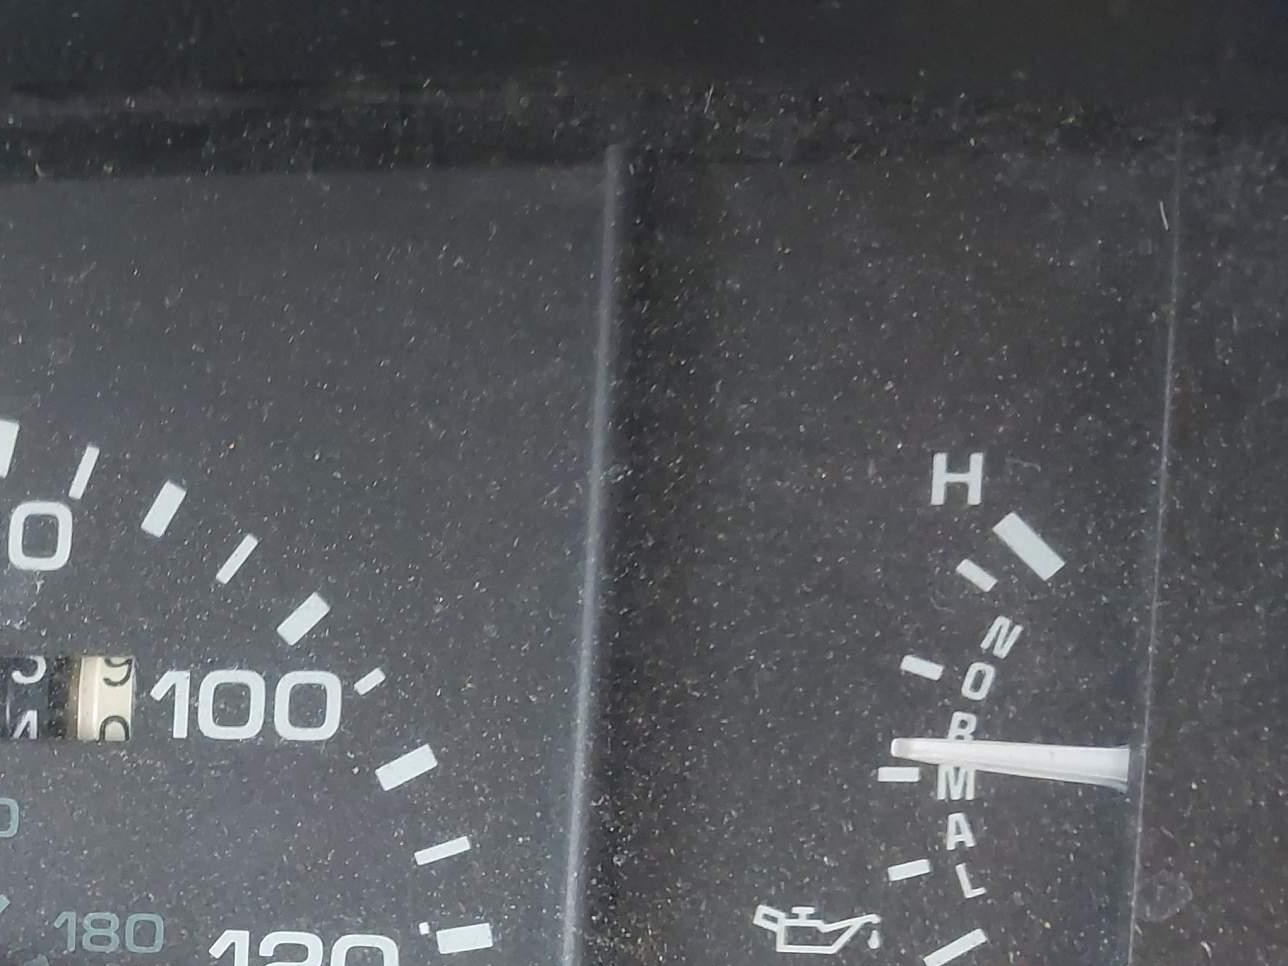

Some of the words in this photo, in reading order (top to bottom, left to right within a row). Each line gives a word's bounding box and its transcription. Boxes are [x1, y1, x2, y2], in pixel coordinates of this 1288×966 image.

[931, 453, 983, 505] H
[150, 665, 342, 742] 100
[53, 911, 165, 953] 180
